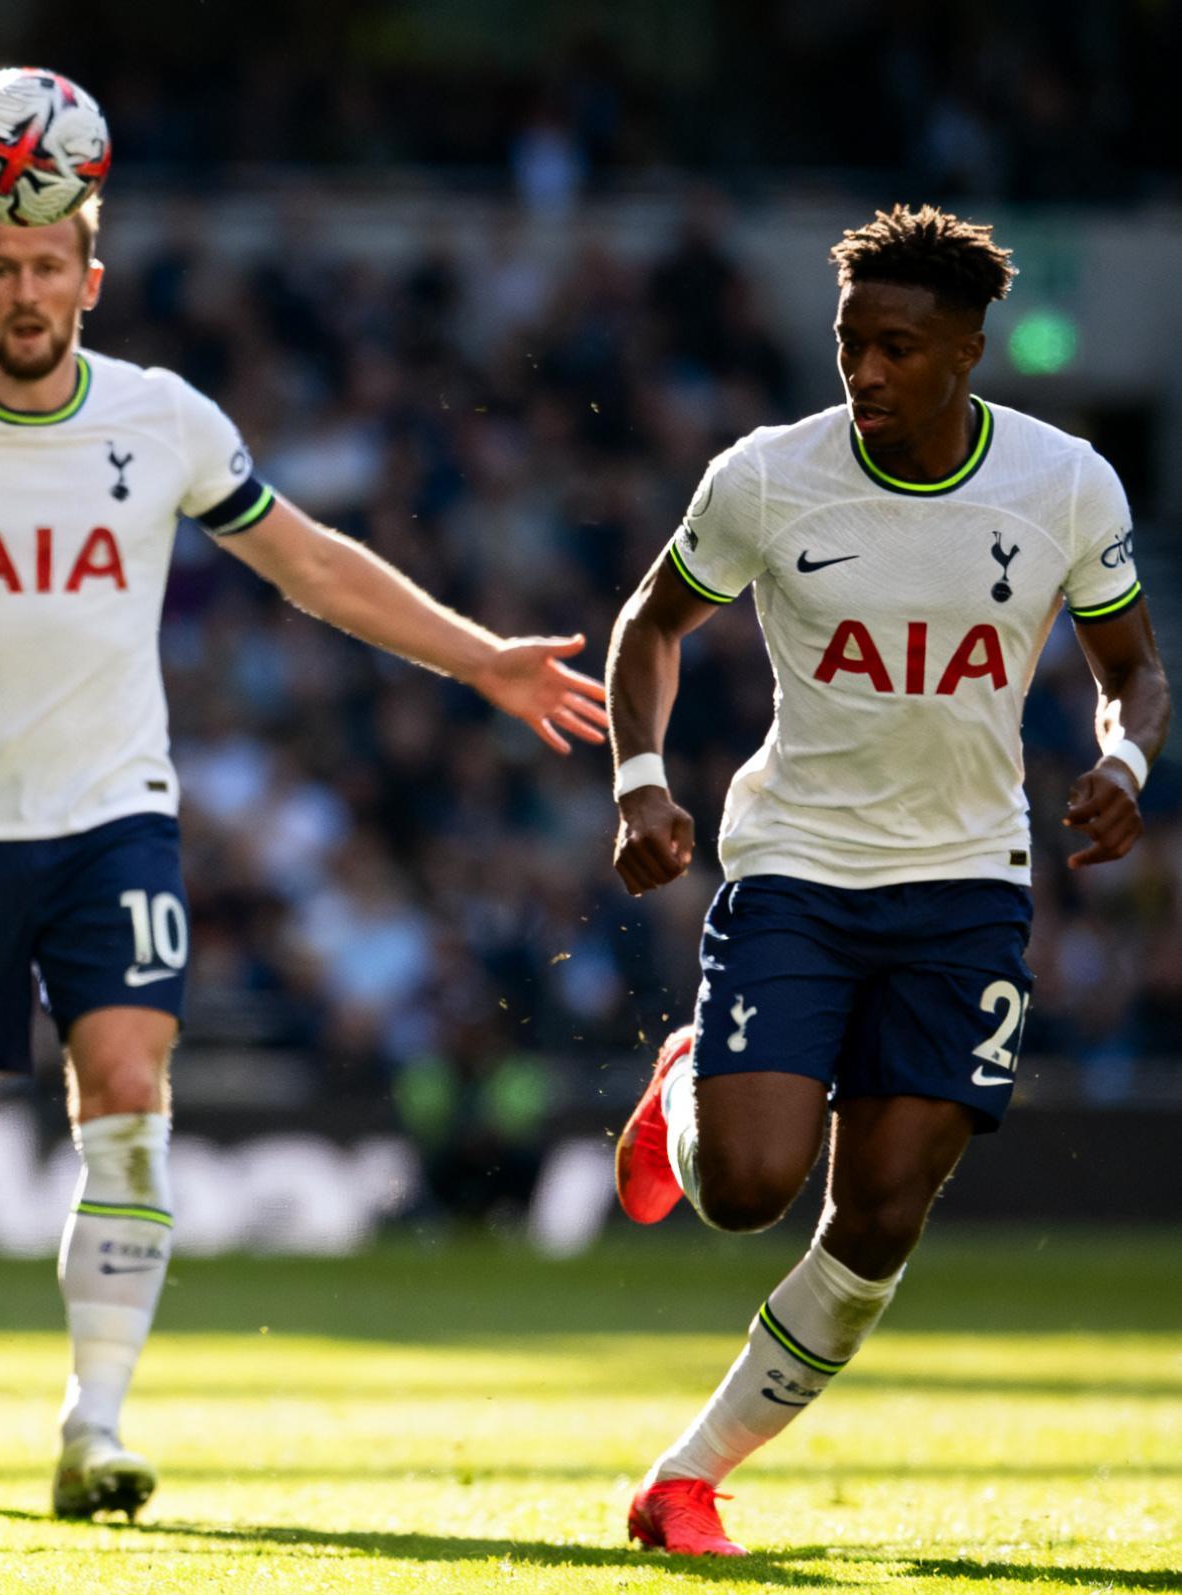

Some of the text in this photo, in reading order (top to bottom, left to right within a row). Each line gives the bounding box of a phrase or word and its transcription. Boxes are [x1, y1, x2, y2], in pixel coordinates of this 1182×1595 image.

[813, 619, 1007, 695] AIA
[120, 889, 188, 969] 10
[971, 980, 1029, 1072] 2
